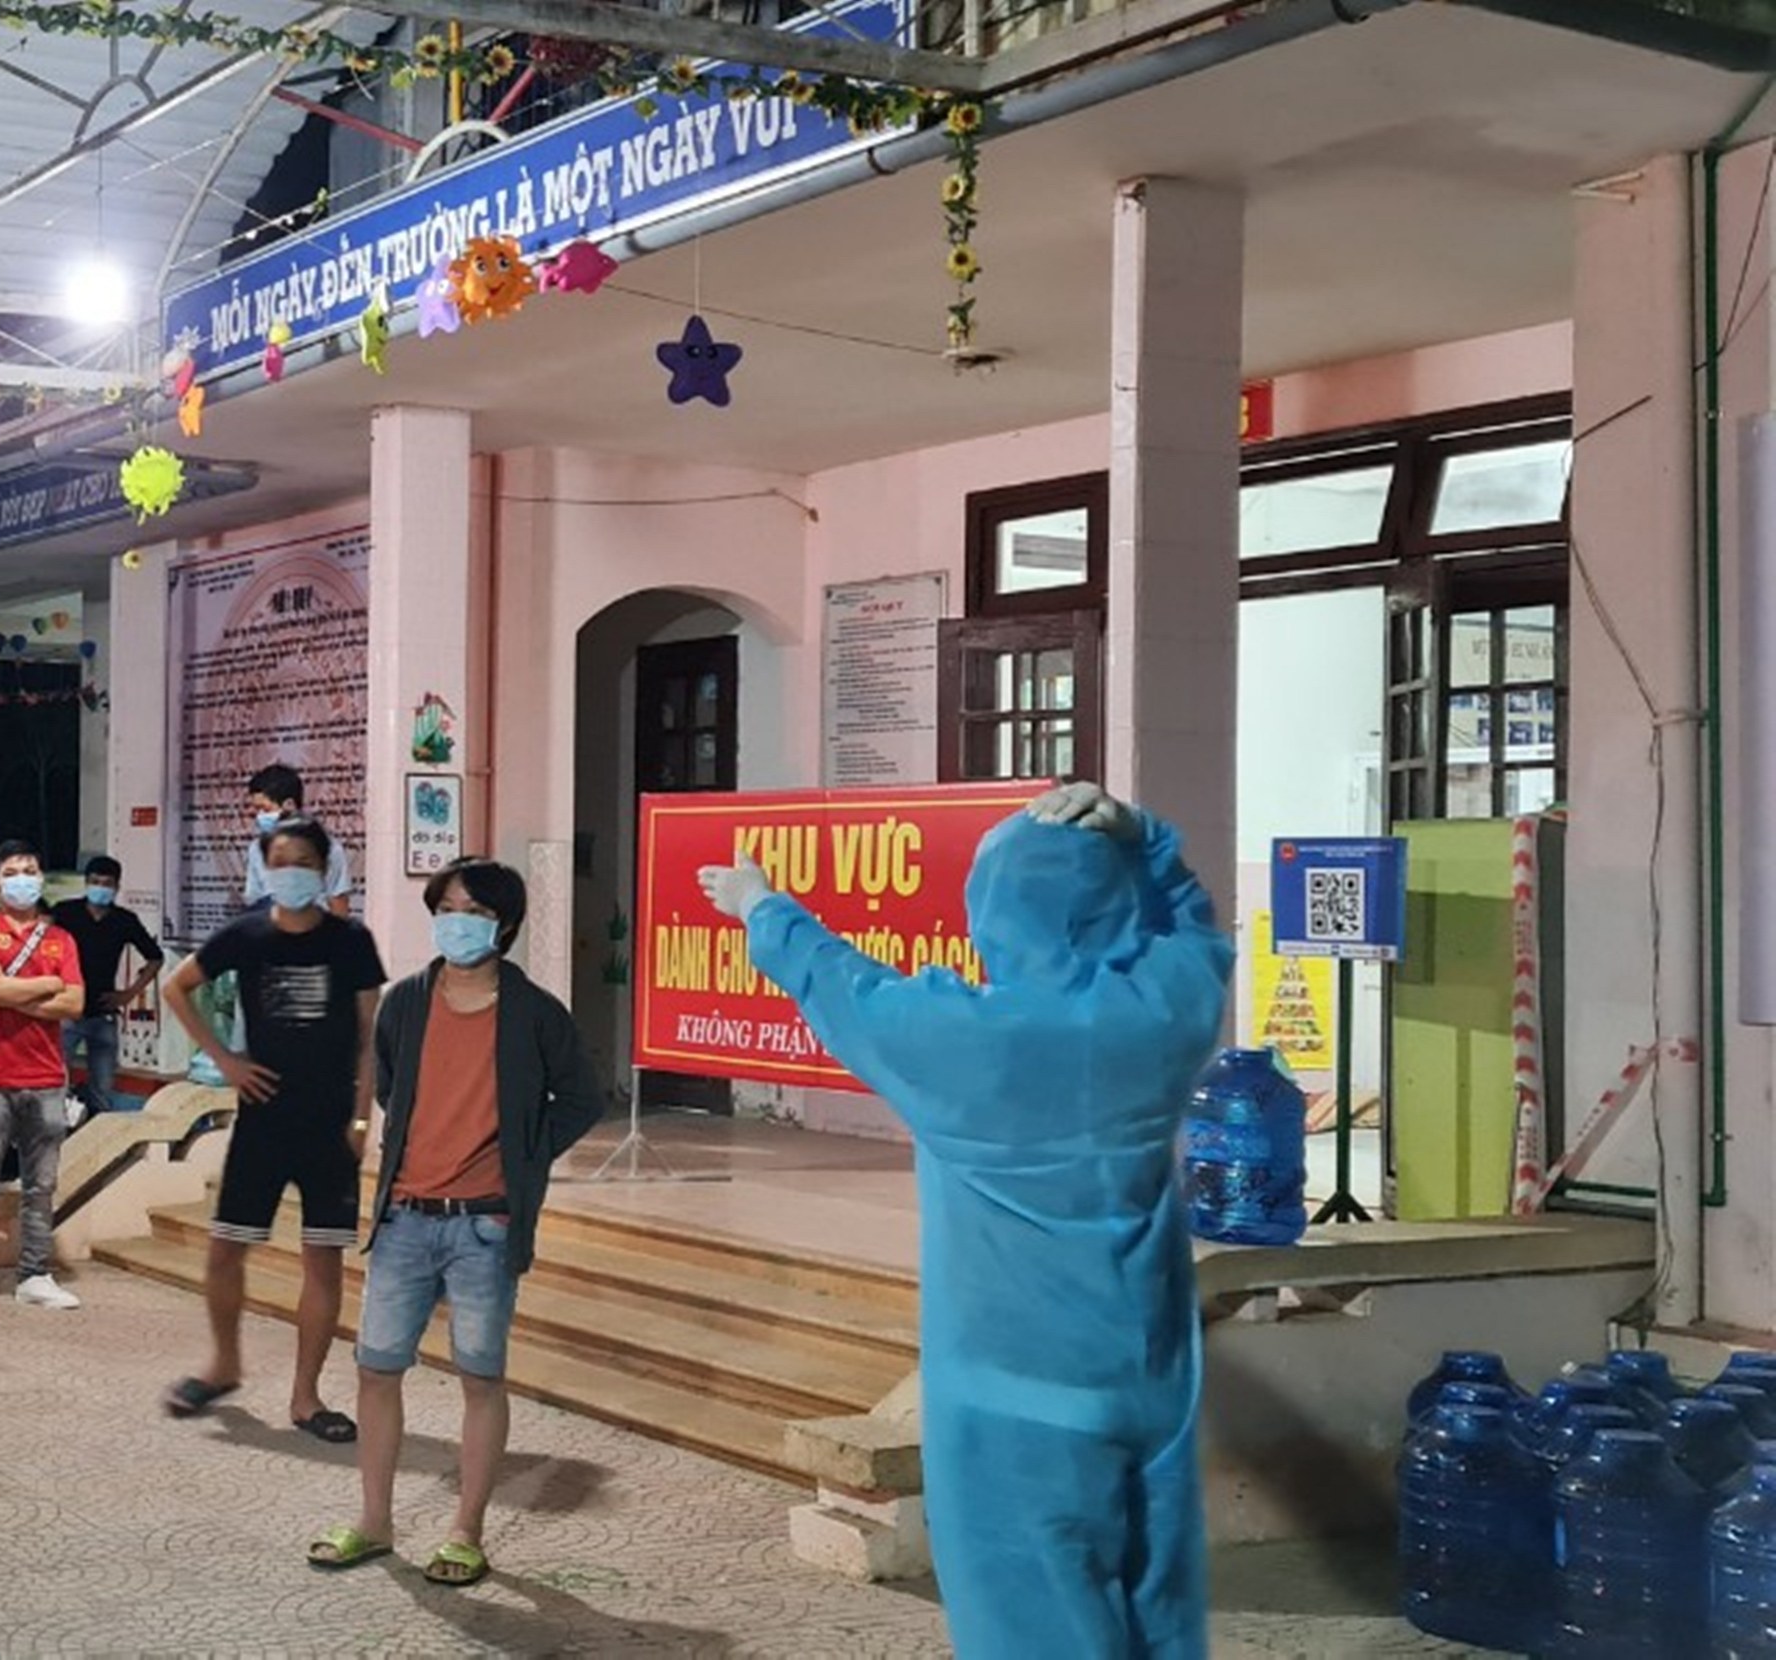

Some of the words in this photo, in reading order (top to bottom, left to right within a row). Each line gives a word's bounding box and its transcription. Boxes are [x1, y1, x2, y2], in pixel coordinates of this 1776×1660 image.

[541, 150, 614, 229] MỘT
[620, 101, 721, 199] NGÀY
[728, 94, 797, 156] VUI
[412, 850, 423, 869] E
[428, 853, 441, 868] e
[733, 824, 818, 894] KHU
[831, 815, 921, 911] VỰC
[656, 912, 711, 991] DÀNH
[677, 1009, 752, 1049] KHÔNG
[756, 1016, 821, 1060] PHẬN
